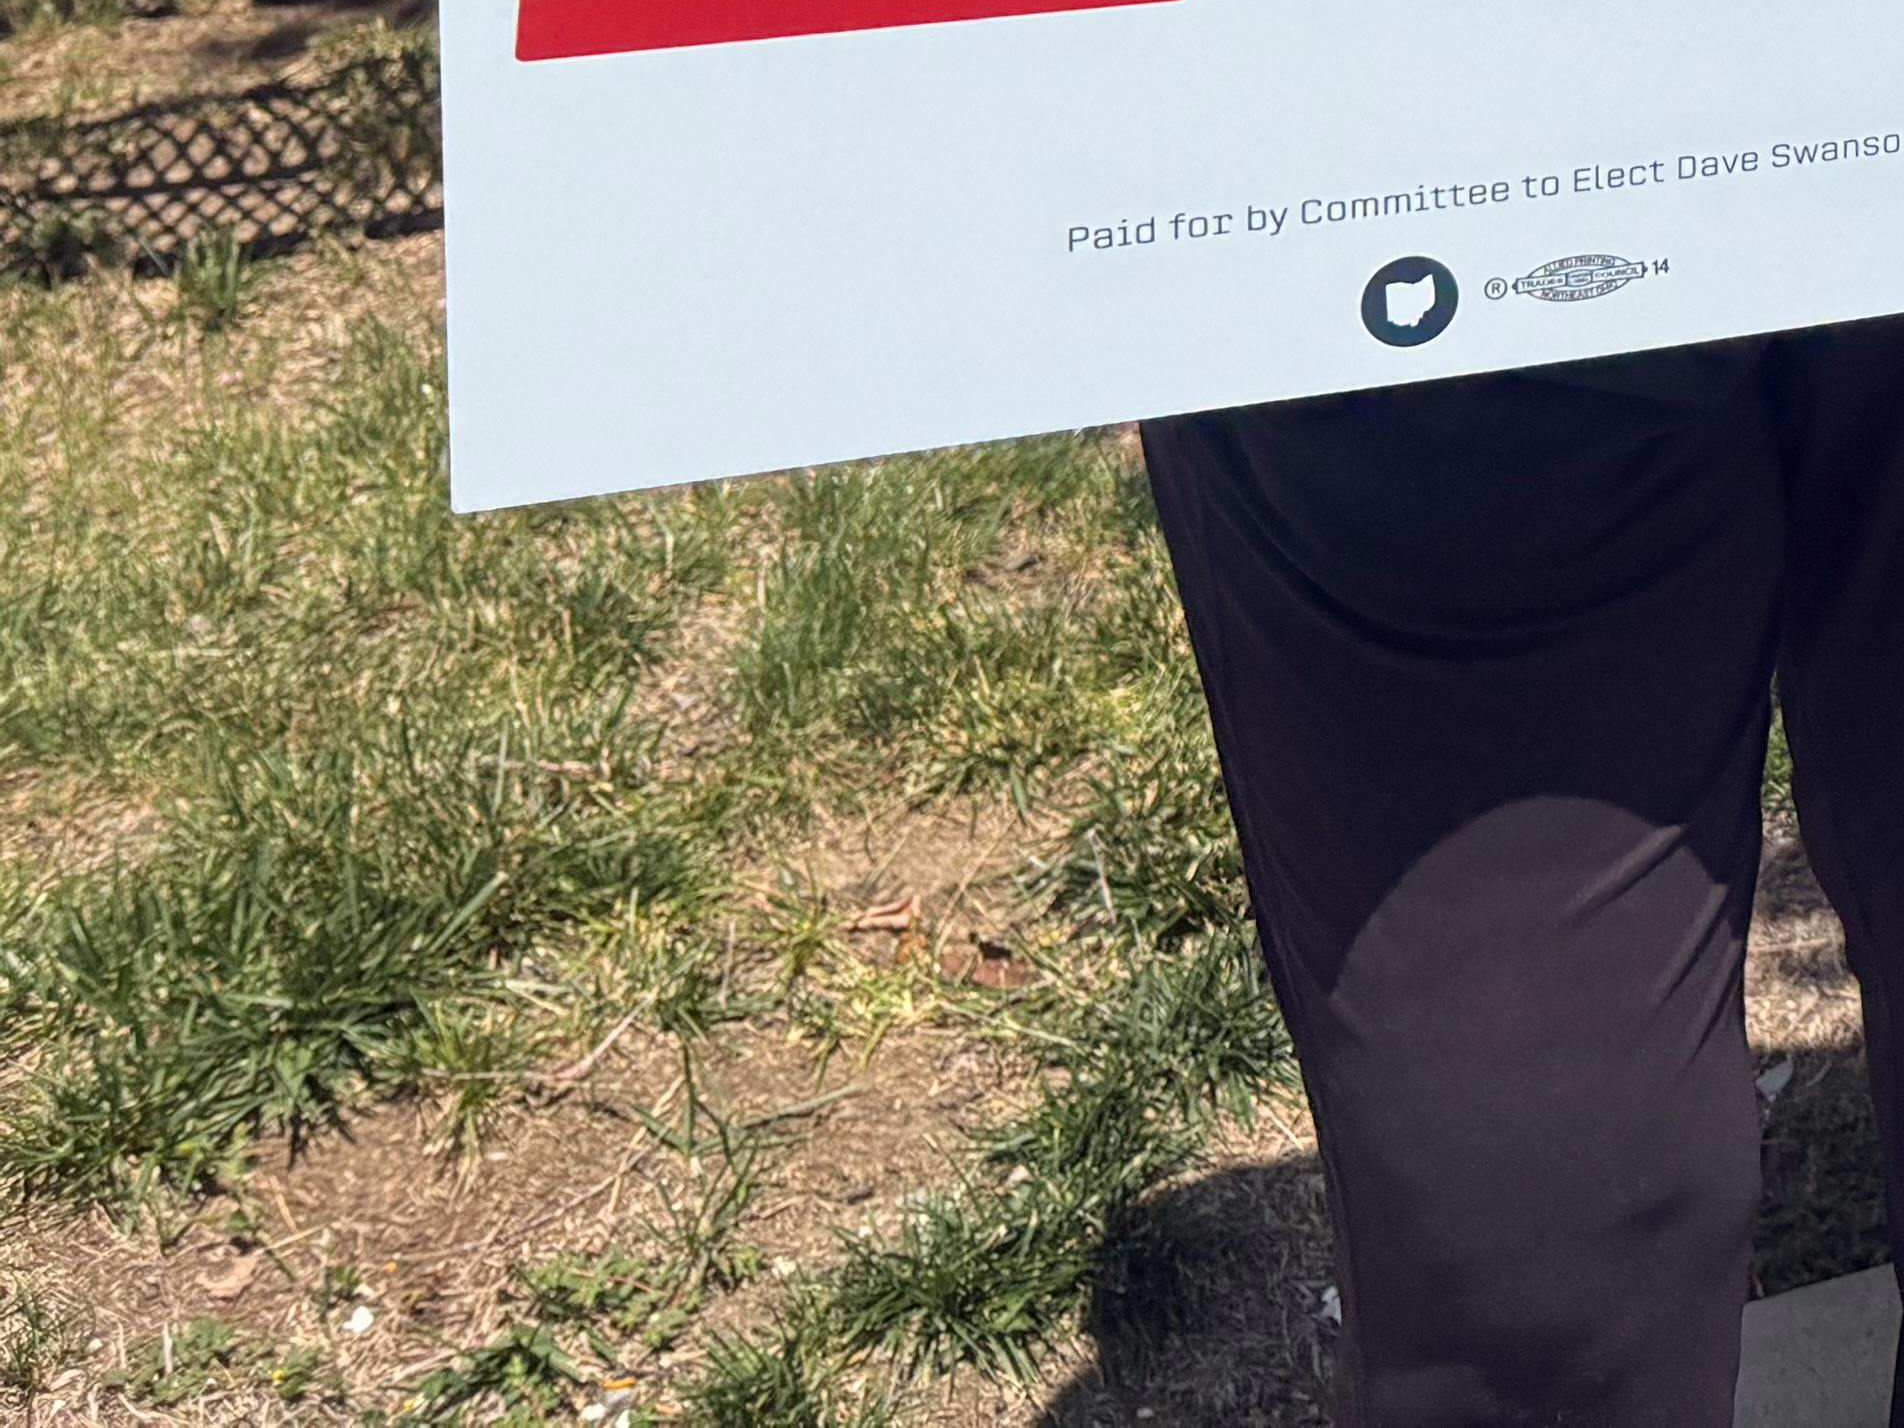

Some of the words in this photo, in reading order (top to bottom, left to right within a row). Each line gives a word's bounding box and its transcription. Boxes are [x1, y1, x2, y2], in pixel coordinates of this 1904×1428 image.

[1067, 215, 1155, 253] Paid
[1169, 209, 1235, 242] for
[1246, 201, 1290, 237] by
[1300, 177, 1511, 227] Committee
[1521, 170, 1562, 200] to
[1573, 157, 1667, 195] Elect
[1676, 144, 1760, 182] Dave
[1652, 258, 1669, 275] 14
